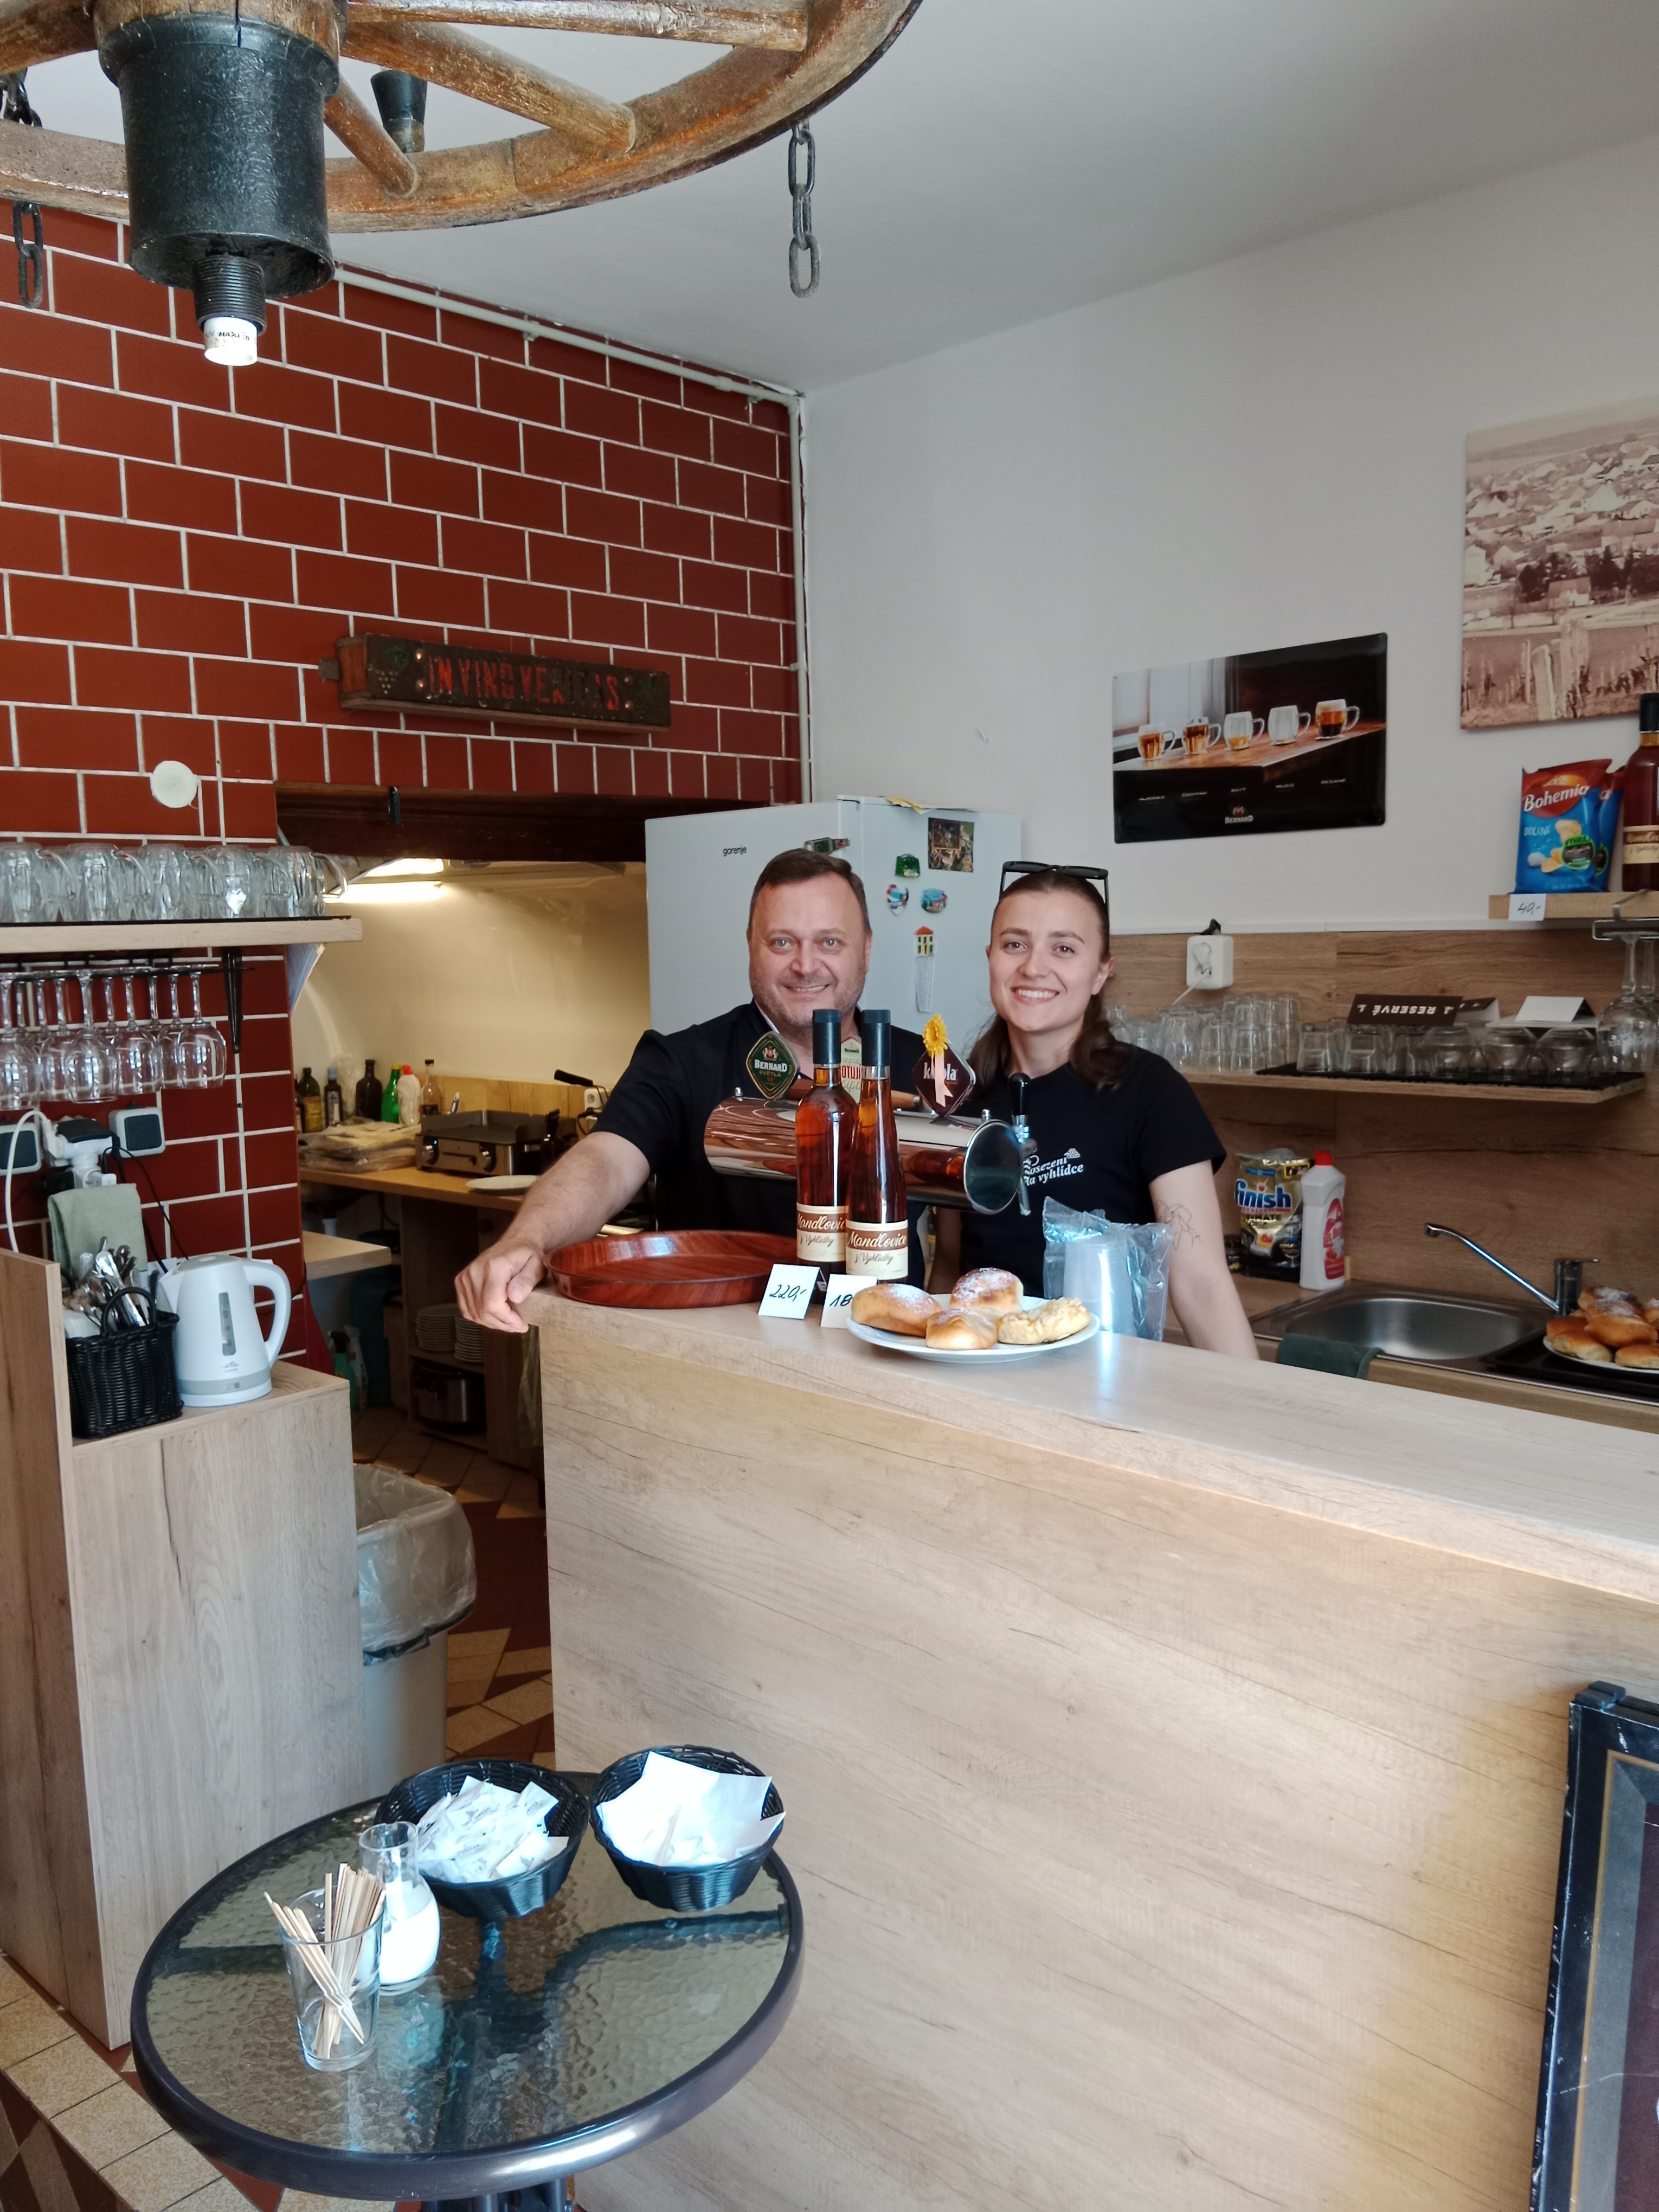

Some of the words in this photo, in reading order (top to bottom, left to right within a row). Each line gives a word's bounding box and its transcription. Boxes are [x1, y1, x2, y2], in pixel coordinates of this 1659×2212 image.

[428, 655, 453, 694] IN
[458, 658, 515, 699] VINO
[1523, 784, 1590, 812] Bohemia
[1224, 814, 1254, 824] BERNARD
[723, 845, 747, 857] gorenje
[1372, 1005, 1436, 1016] RESERVÉ
[754, 1059, 787, 1072] BERNARD
[923, 1062, 957, 1081] kla
[1234, 1179, 1292, 1208] finish
[798, 1214, 847, 1230] Mandlovic
[847, 1231, 907, 1248] Mandlovice
